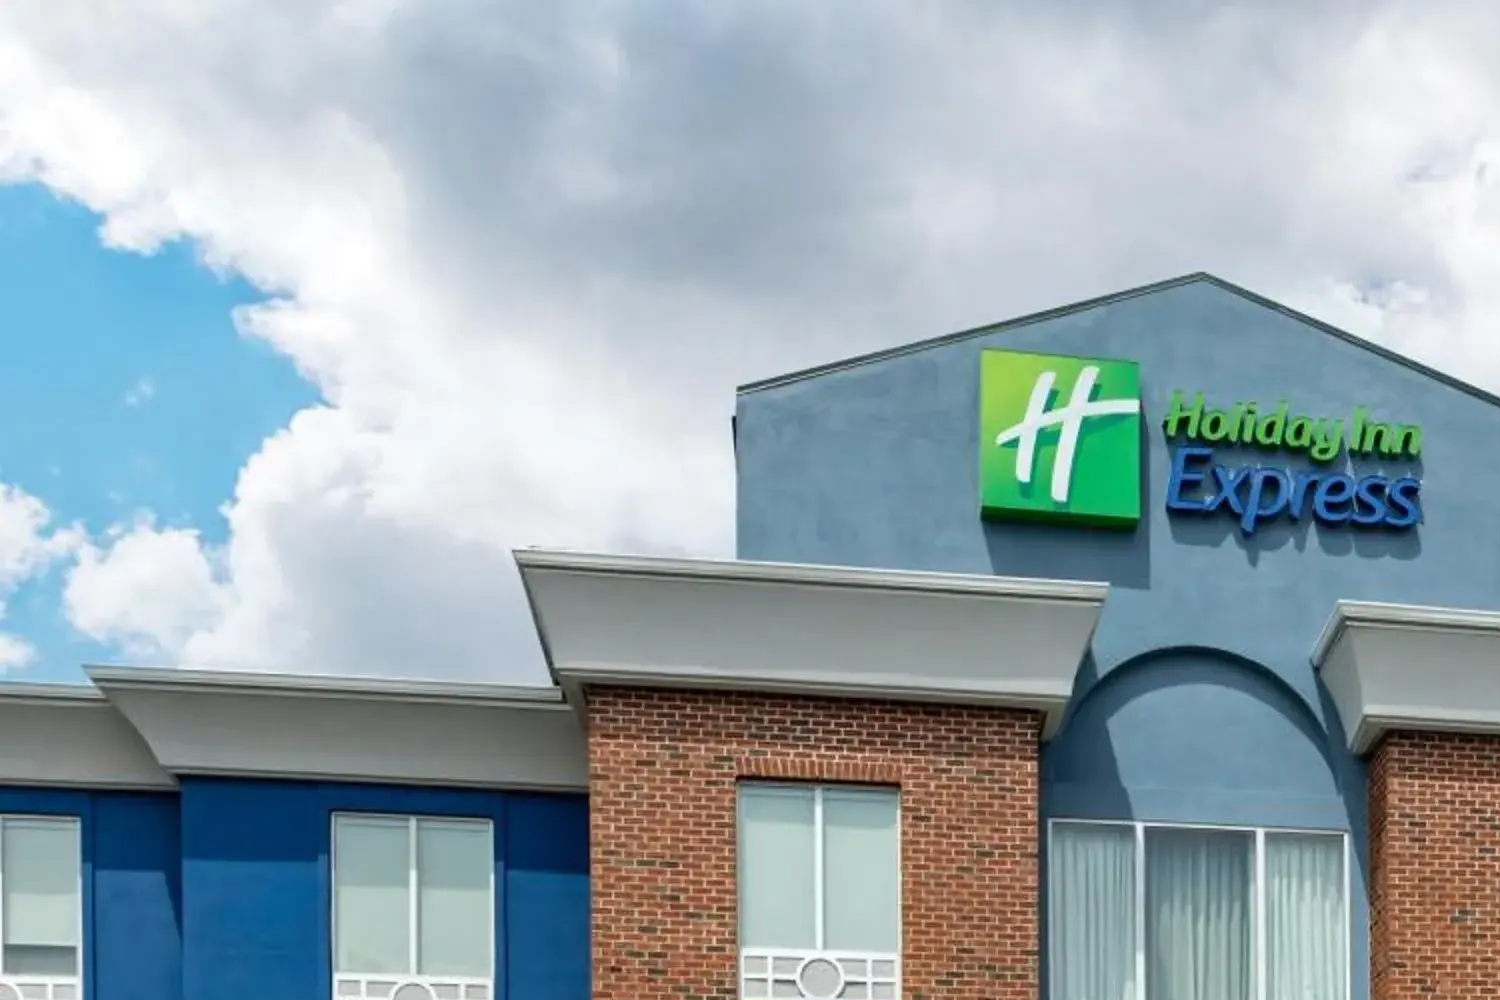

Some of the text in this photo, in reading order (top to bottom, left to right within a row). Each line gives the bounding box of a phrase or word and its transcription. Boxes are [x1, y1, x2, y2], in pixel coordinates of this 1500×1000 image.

[1164, 390, 1421, 461] Holiday Inn
[1166, 447, 1422, 536] Express
